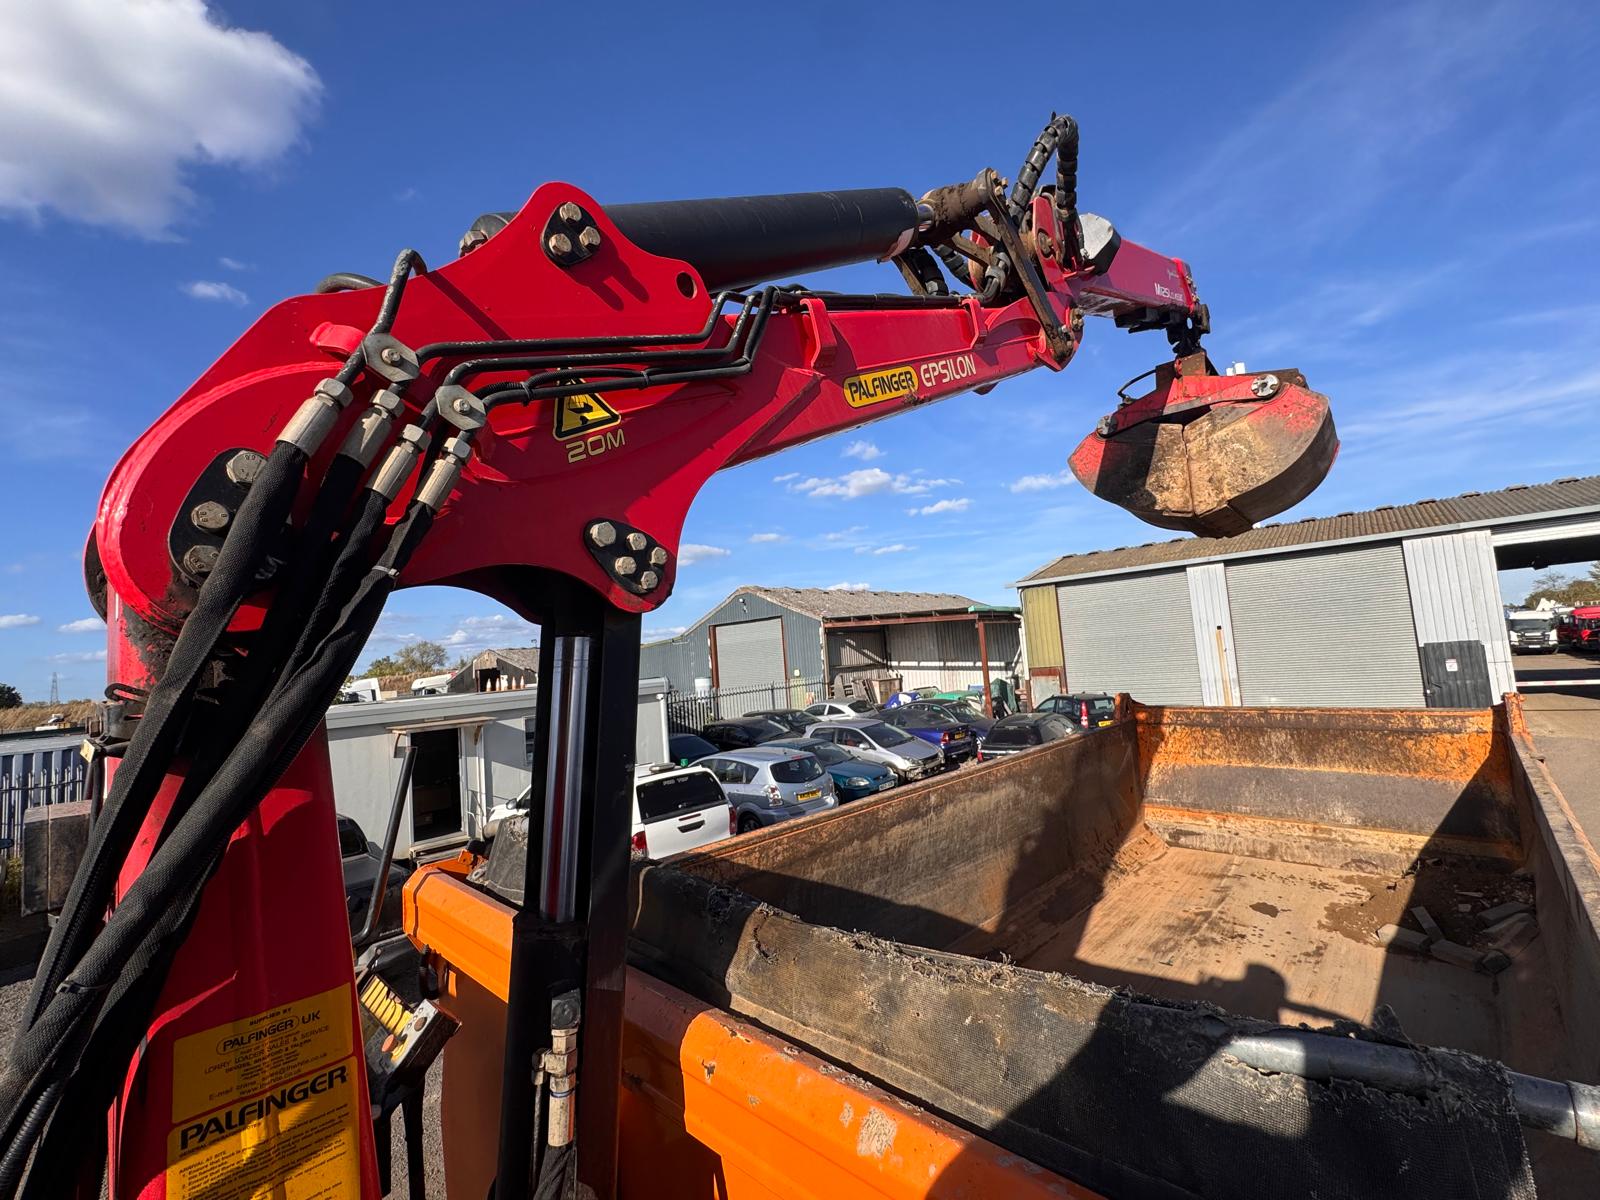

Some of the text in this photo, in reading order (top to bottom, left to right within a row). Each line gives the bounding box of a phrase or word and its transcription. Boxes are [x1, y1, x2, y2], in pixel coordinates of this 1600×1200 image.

[848, 354, 977, 402] PALFINGER EPSILON
[566, 429, 626, 463] 20M
[223, 1019, 294, 1052] PALFINGER
[301, 1009, 320, 1024] UK
[300, 1025, 329, 1039] SERVICE
[180, 1065, 349, 1150] PALFINGER
